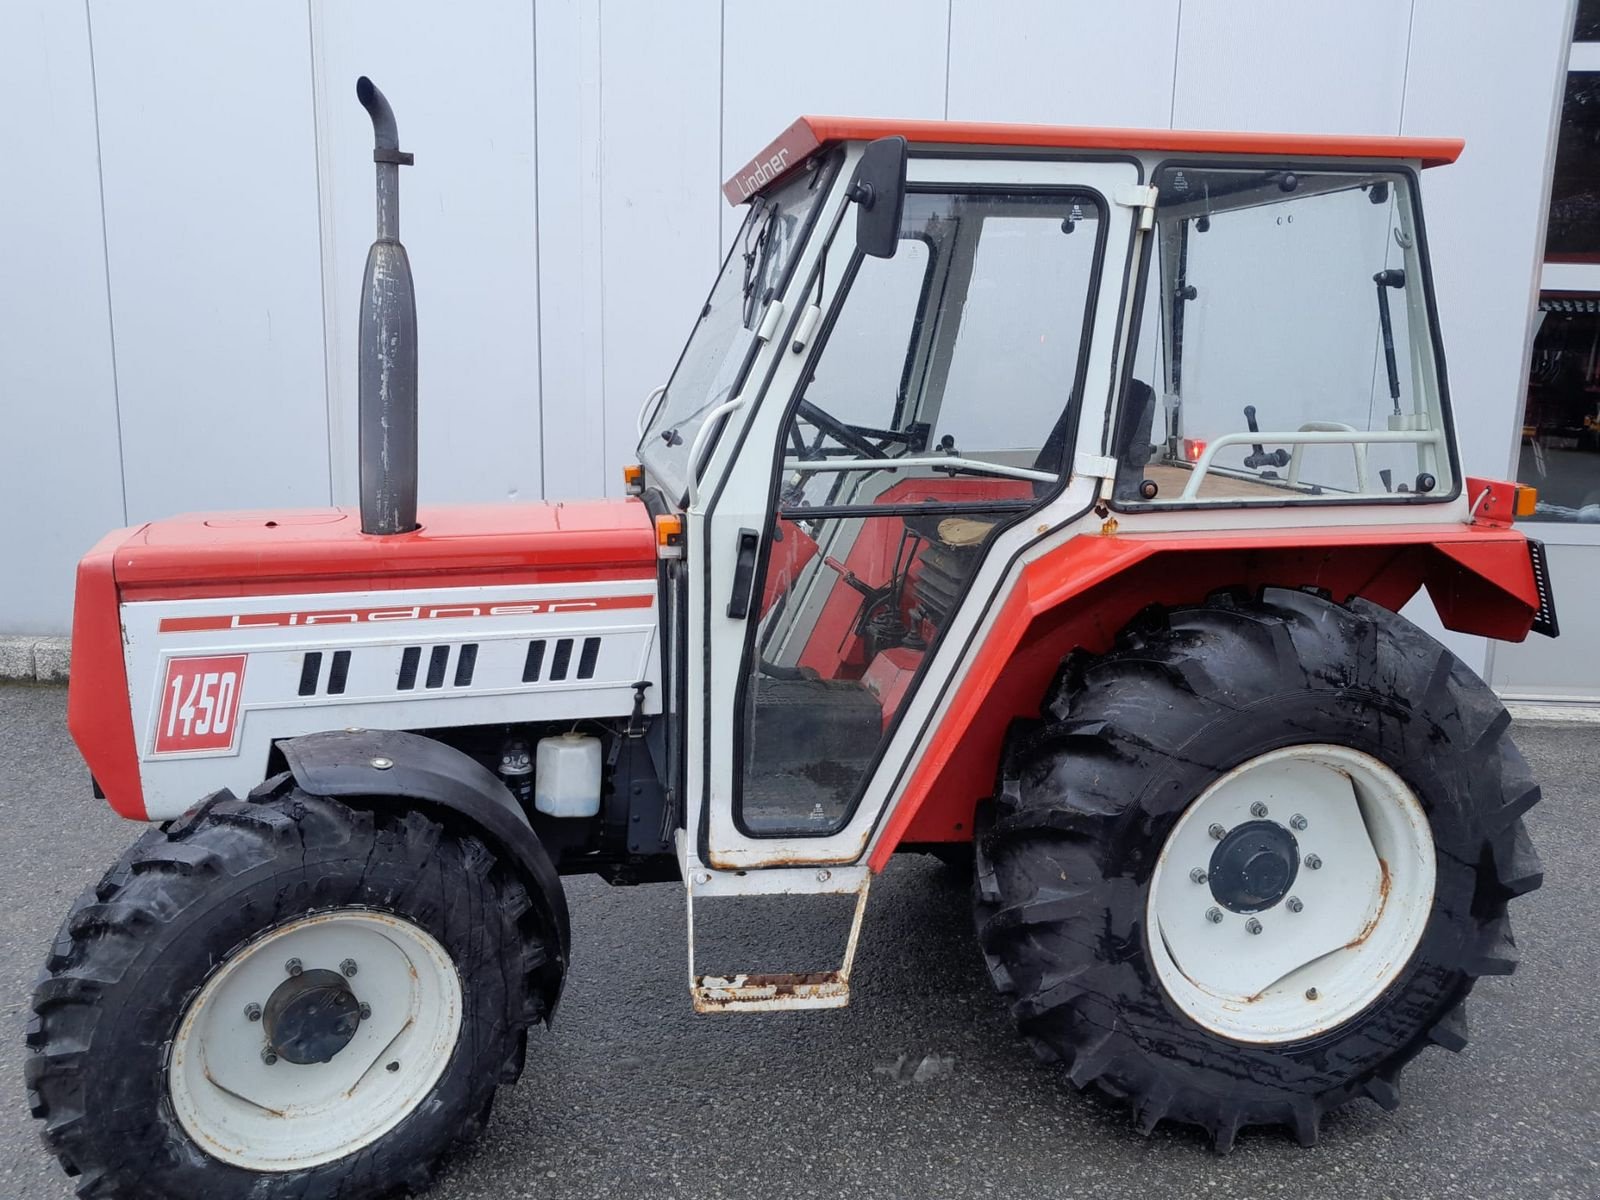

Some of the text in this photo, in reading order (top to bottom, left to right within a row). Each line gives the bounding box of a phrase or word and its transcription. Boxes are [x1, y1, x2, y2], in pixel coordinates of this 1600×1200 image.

[735, 147, 789, 197] Lindner
[230, 602, 598, 628] Lindner
[166, 671, 237, 737] 1450
